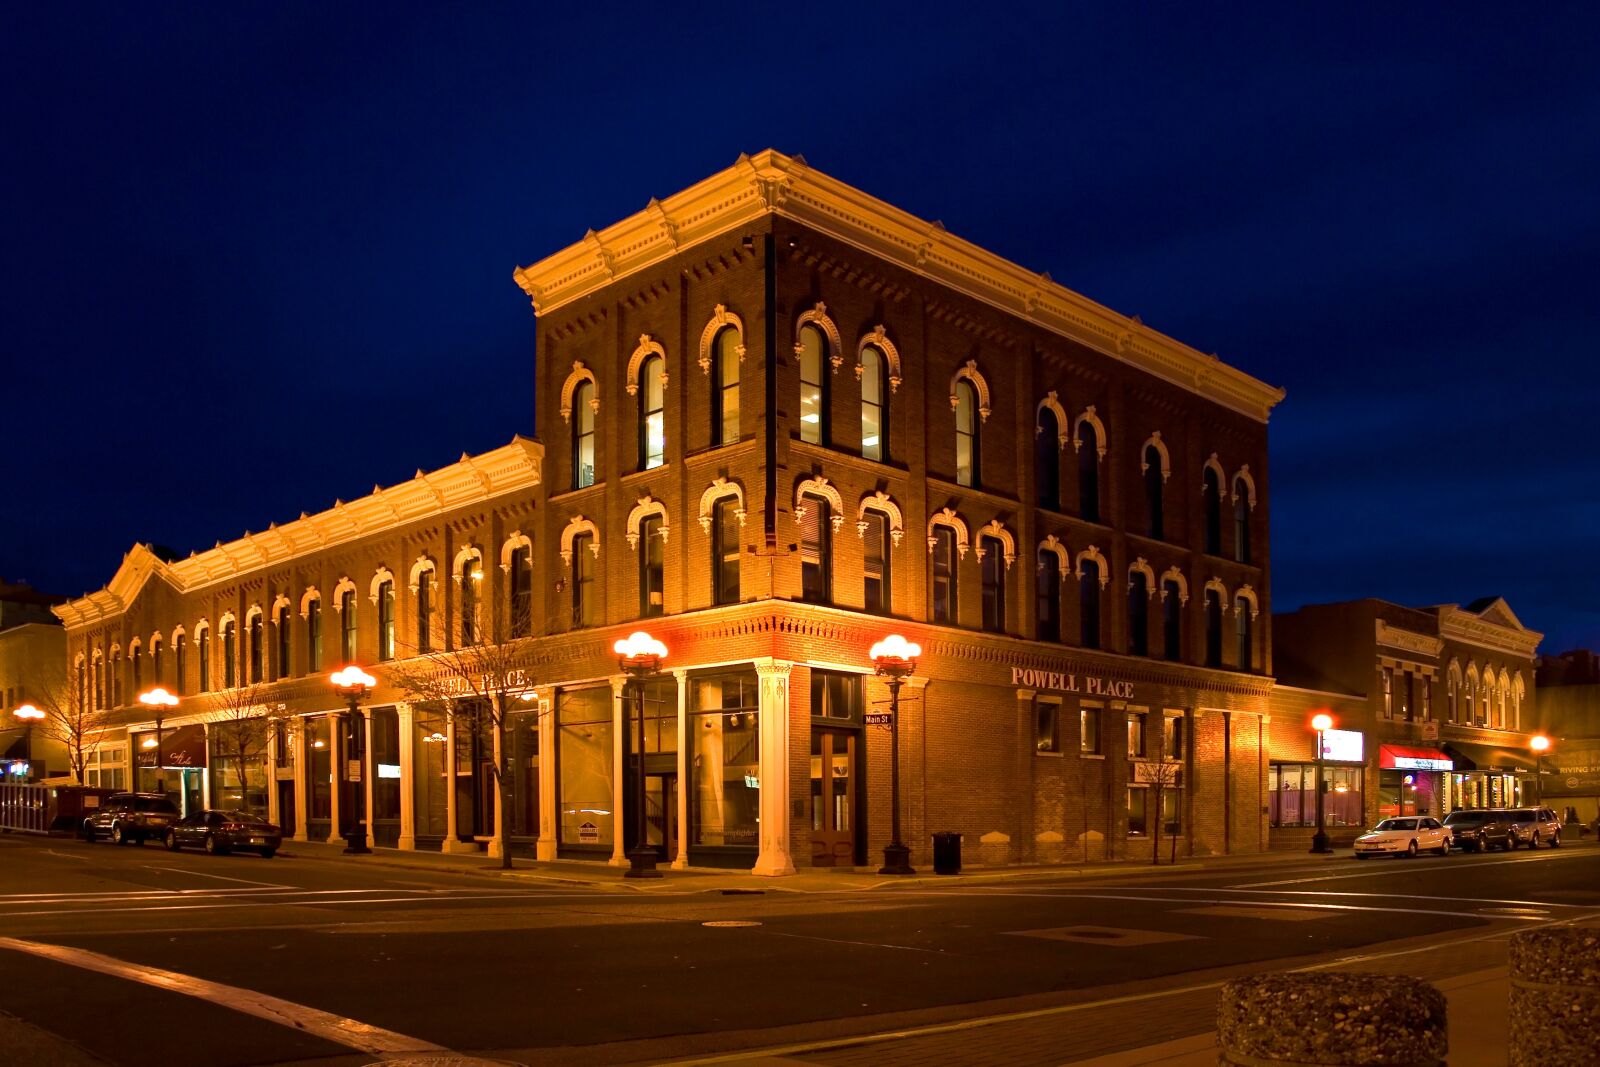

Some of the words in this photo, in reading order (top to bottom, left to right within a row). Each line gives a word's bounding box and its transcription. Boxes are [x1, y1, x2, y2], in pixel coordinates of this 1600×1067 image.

[427, 677, 473, 694] OWELL
[1011, 667, 1079, 692] POWELL
[1086, 677, 1134, 698] PLACE
[865, 715, 880, 724] Main
[881, 714, 888, 723] St
[1559, 766, 1589, 774] RIVING
